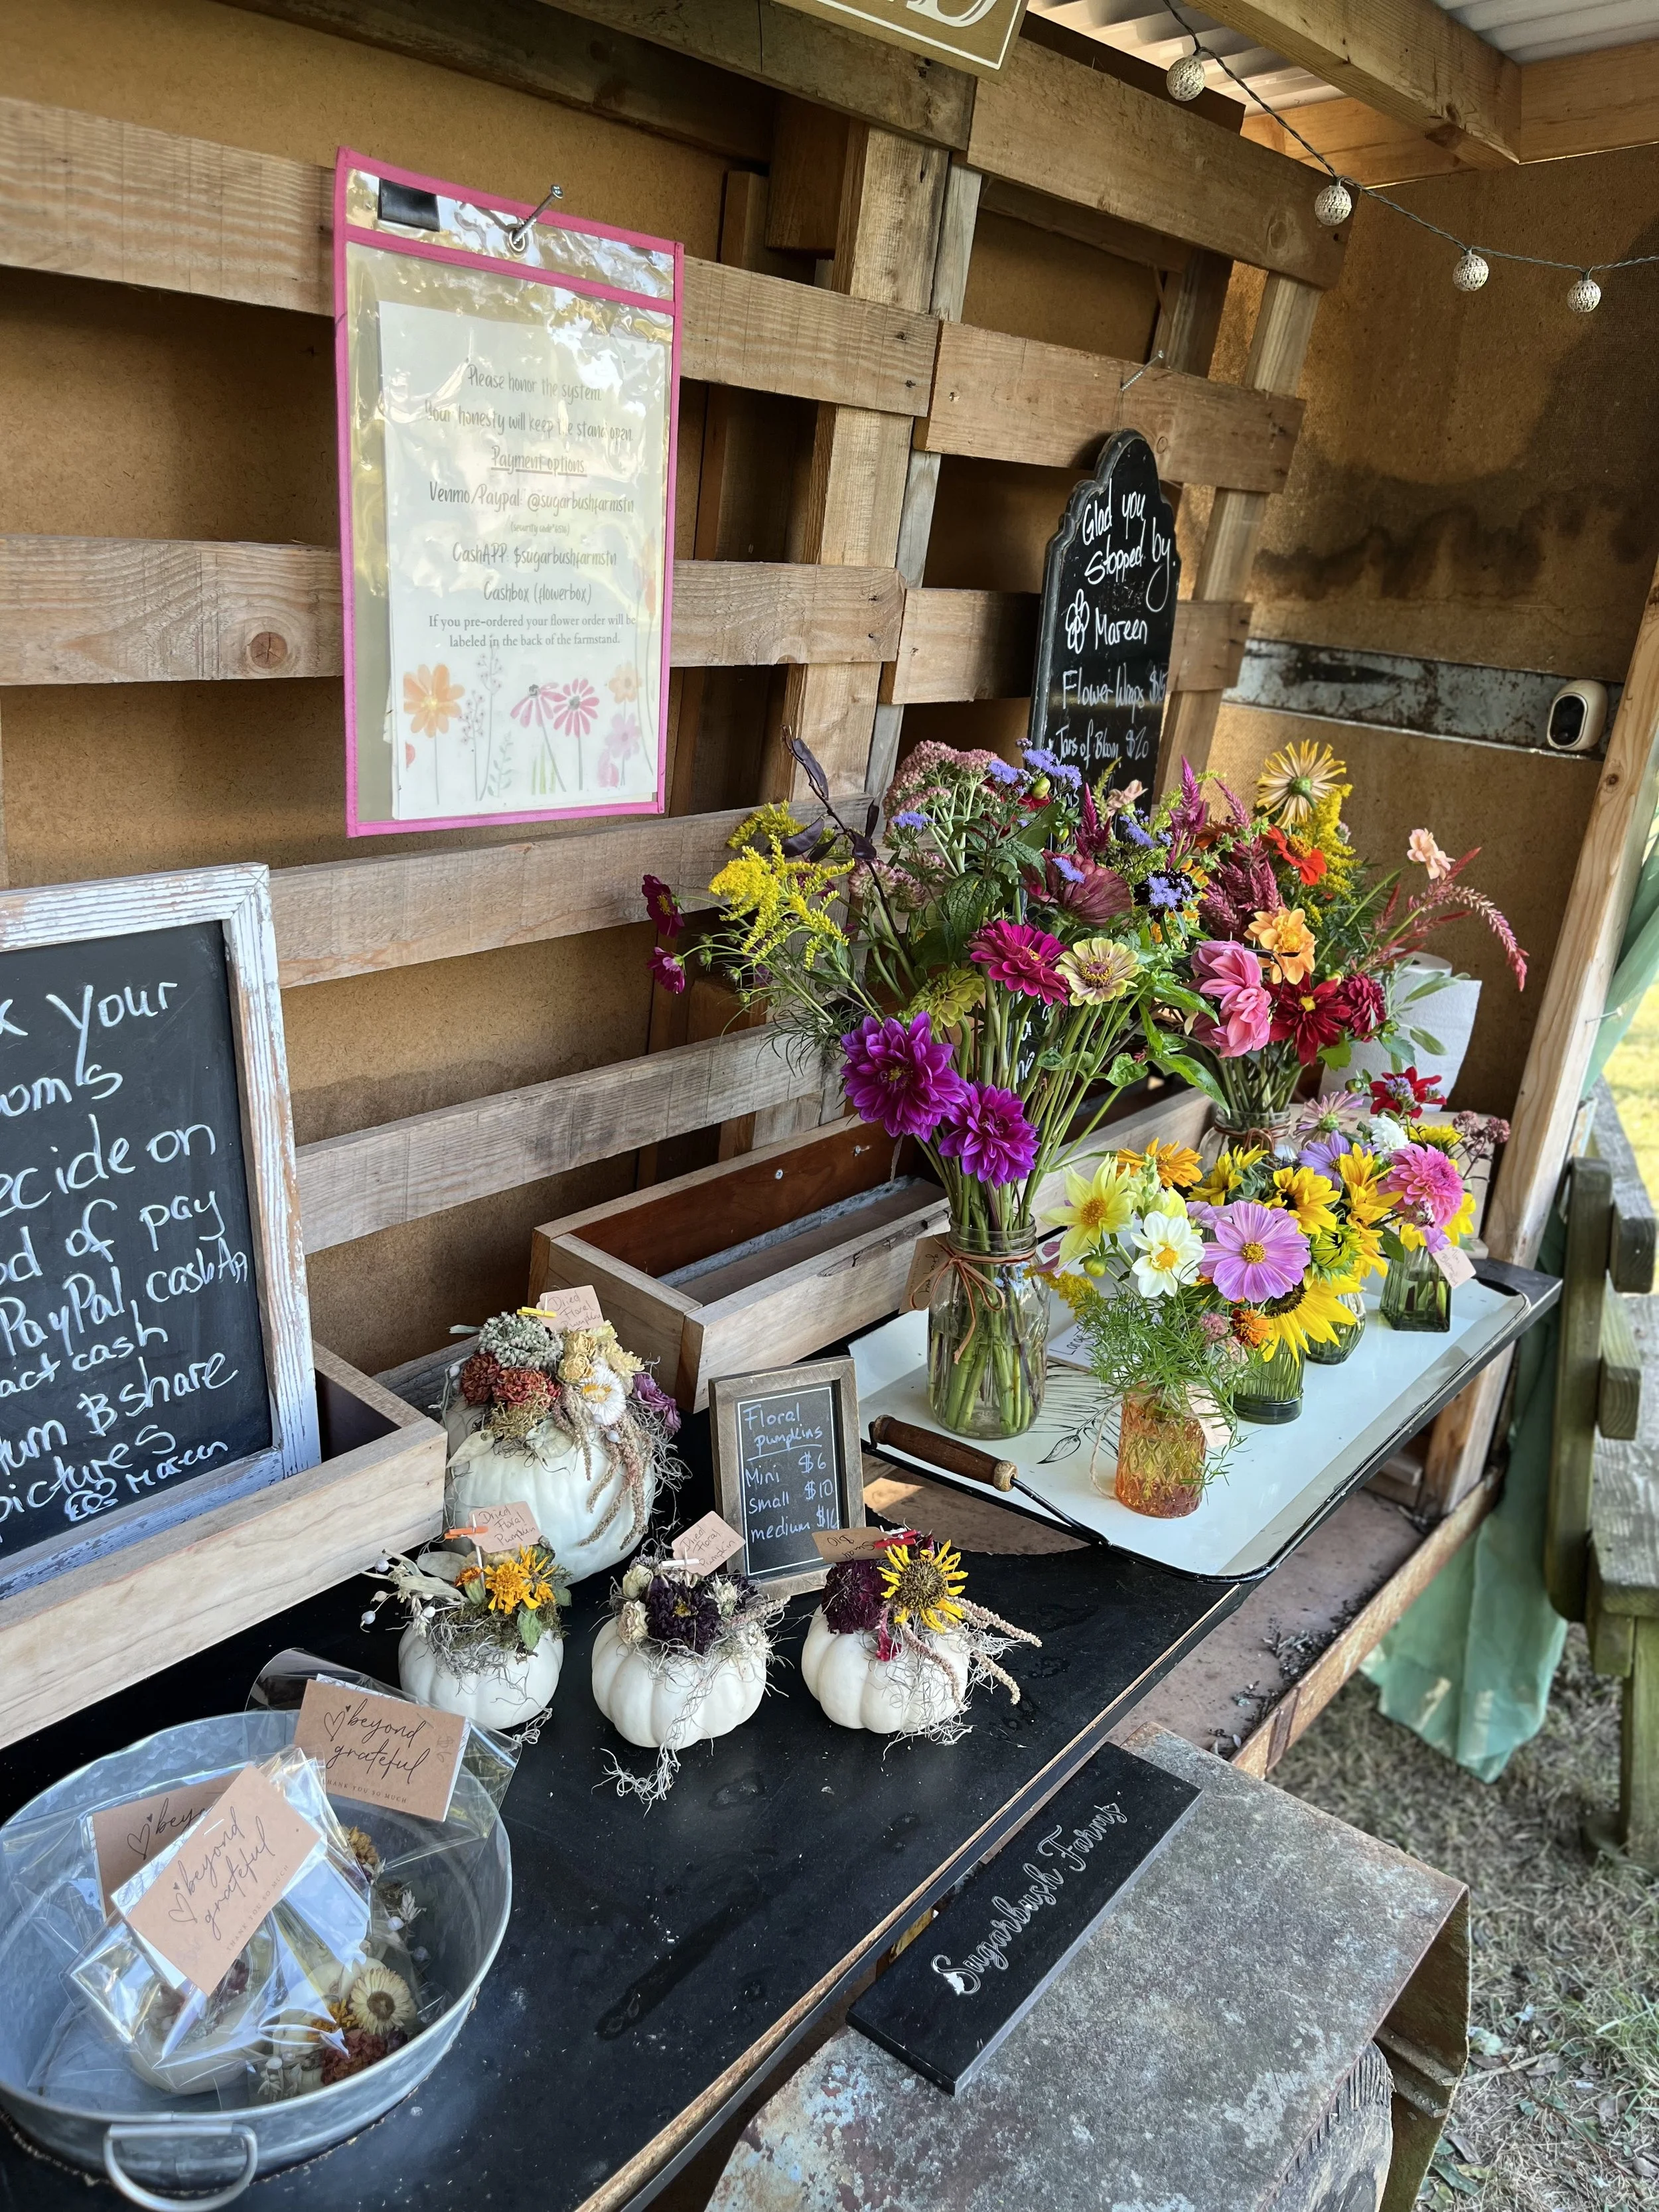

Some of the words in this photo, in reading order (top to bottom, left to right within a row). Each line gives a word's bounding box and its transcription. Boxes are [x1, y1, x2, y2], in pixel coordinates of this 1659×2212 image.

[468, 364, 504, 388] Please
[508, 372, 537, 393] honor
[541, 378, 557, 397] the
[459, 404, 504, 435] honesty
[509, 412, 526, 431] will
[530, 413, 553, 439] keep
[491, 445, 543, 475] Payment
[1082, 478, 1112, 546] Glad
[1122, 491, 1146, 540] you
[514, 546, 616, 572] $sugarbushfarmstn
[484, 581, 530, 603] Cashbox
[534, 582, 591, 605] (flowerbox)
[429, 614, 439, 627] If
[441, 619, 461, 631] you
[465, 614, 523, 630] pre-ordered
[526, 618, 548, 630] your
[551, 613, 579, 626] flower
[581, 613, 605, 625] order
[608, 613, 623, 625] will
[626, 613, 636, 625] be
[1096, 607, 1147, 650] Mareen
[450, 634, 486, 647] labeled
[489, 634, 499, 647] in
[502, 634, 518, 646] the
[521, 634, 542, 645] back
[545, 632, 557, 645] of
[557, 633, 571, 645] the
[574, 632, 620, 644] farmstand.
[1063, 666, 1114, 709] Flower
[1056, 724, 1078, 764] Jars
[1080, 719, 1094, 770] of
[1126, 726, 1149, 761] $20
[145, 1124, 216, 1163] on
[65, 1199, 117, 1262] of
[139, 1191, 226, 1252] pay
[548, 1290, 580, 1311] Dried
[559, 1300, 595, 1320] Floral
[72, 1299, 168, 1371] cash
[119, 1353, 240, 1416] share
[743, 1402, 800, 1430] Floral
[745, 1465, 780, 1487] Mini
[798, 1451, 827, 1473] $6
[804, 1477, 834, 1501] $10
[478, 1505, 510, 1524] Dried
[494, 1511, 526, 1532] Floral
[751, 1516, 811, 1544] medium
[494, 1524, 536, 1545] Pumpkin
[680, 1524, 706, 1551] Dried
[693, 1528, 721, 1554] Floral
[699, 1540, 736, 1568] Pumpkin
[348, 1698, 427, 1748] beyond
[326, 1738, 431, 1785] grateful
[352, 1785, 368, 1794] YOU
[385, 1793, 407, 1803] MUCH
[178, 1806, 246, 1896] beyond
[204, 1816, 276, 1941] grateful
[226, 1923, 249, 1952] THANK
[248, 1903, 263, 1921] YOU
[262, 1891, 271, 1902] SO
[271, 1864, 289, 1888] MUCH
[931, 1863, 1064, 1995] Sugarbush
[1037, 1802, 1128, 1872] Farms
